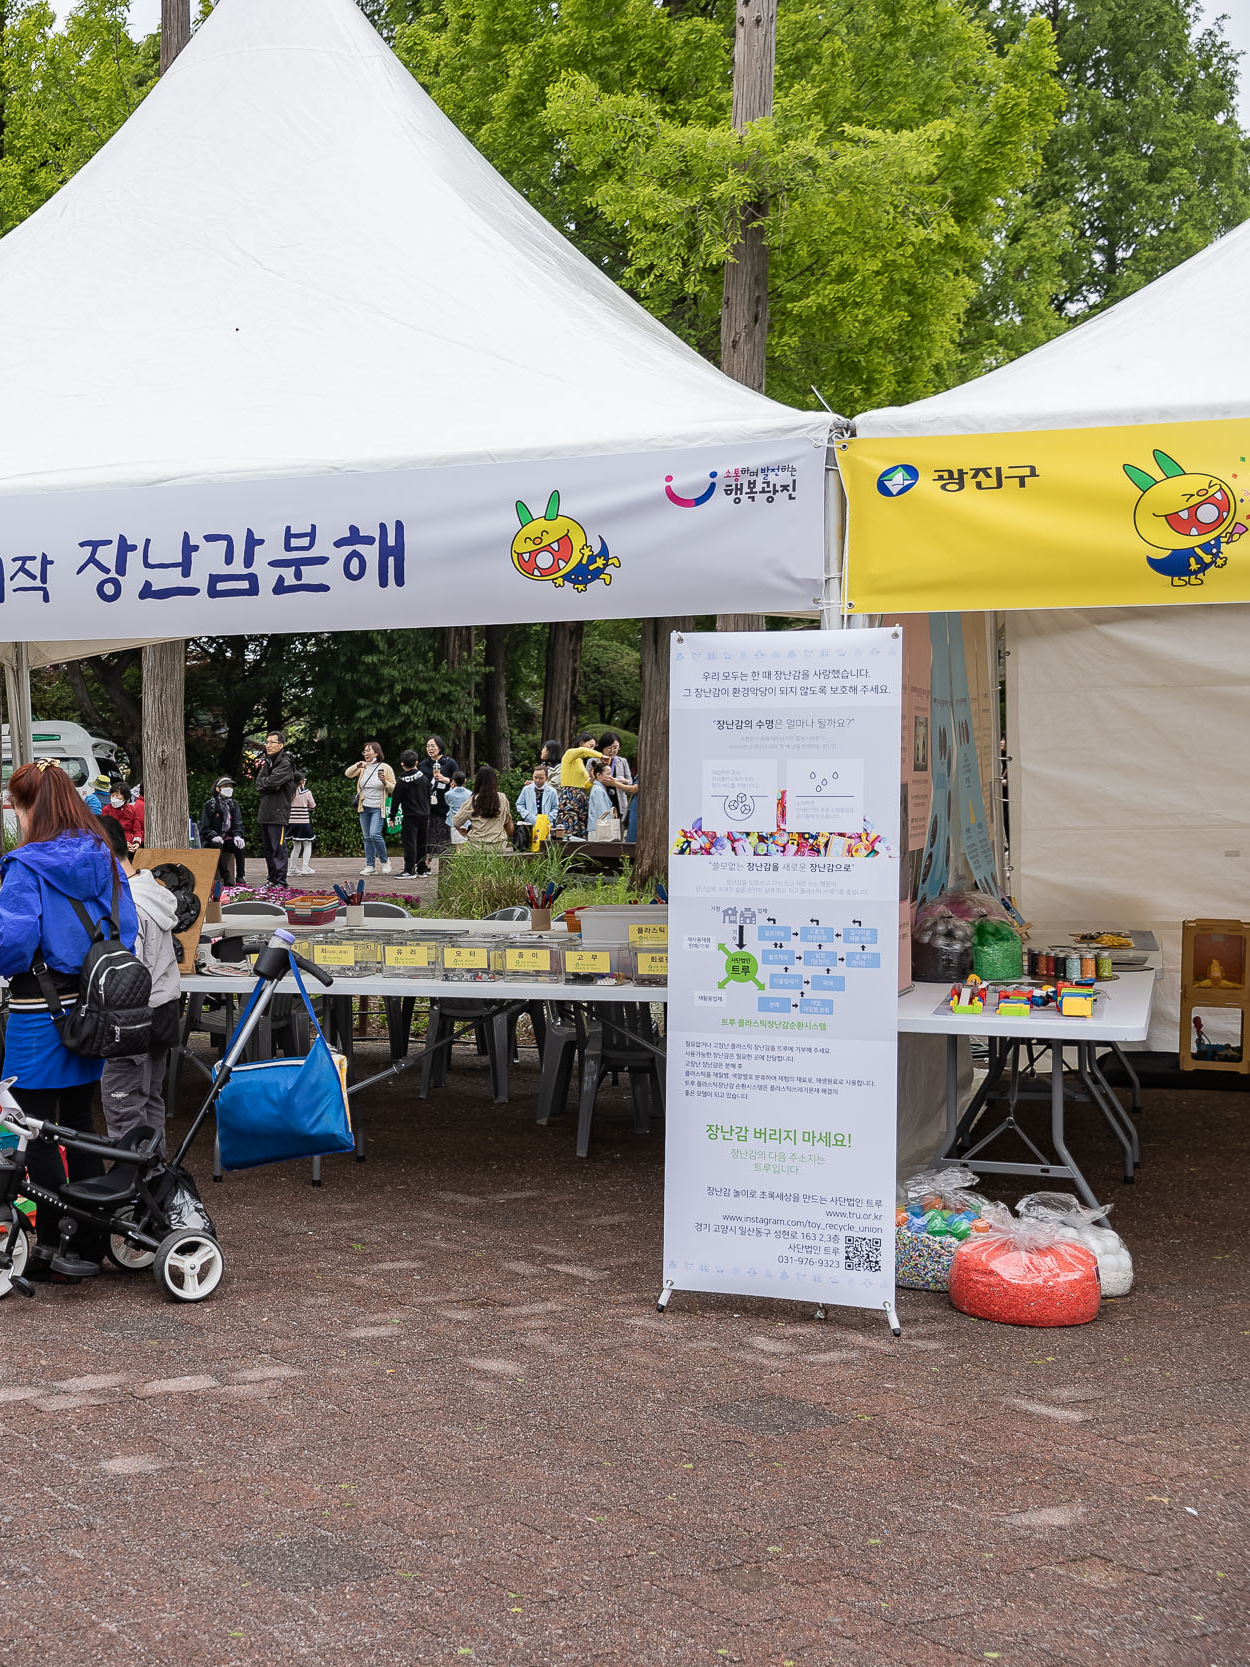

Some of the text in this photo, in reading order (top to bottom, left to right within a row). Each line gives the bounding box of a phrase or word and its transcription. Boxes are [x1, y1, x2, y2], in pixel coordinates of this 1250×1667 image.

[724, 464, 797, 482] 소통하며 발전하는
[932, 465, 1039, 492] 광진구
[724, 479, 796, 504] 행복광진
[76, 519, 405, 603] 장난감분해
[702, 668, 871, 682] 우리 모두는 한 때 장난감을 사랑했습니다.
[682, 684, 891, 698] 그 장난감이 환경악당이 되지 않도록 보호해 주세요.
[755, 719, 784, 729] 수명은
[786, 718, 815, 729] 얼마나
[746, 862, 780, 872] 장난감을
[781, 863, 807, 872] 새로운
[731, 965, 751, 976] 트루
[721, 1018, 736, 1026] 트루
[705, 1124, 852, 1148] 장난감 버리지 마세요!
[729, 1148, 826, 1165] 장난감의 다음 주소지는
[706, 1186, 883, 1209] 장난감 놀이로 초록세상을 만드는 사단법인 트루
[825, 1210, 883, 1221] www.tru.or.kr
[722, 1213, 883, 1234] www.instagram.com/toy_recycle_union
[694, 1222, 711, 1233] 경기
[713, 1223, 737, 1234] 고양시
[738, 1225, 771, 1238] 일산동구
[773, 1228, 798, 1240] 성현로
[800, 1231, 817, 1241] 163
[787, 1242, 840, 1256] 사단법인 트루
[777, 1255, 840, 1269] 031-976-9323
